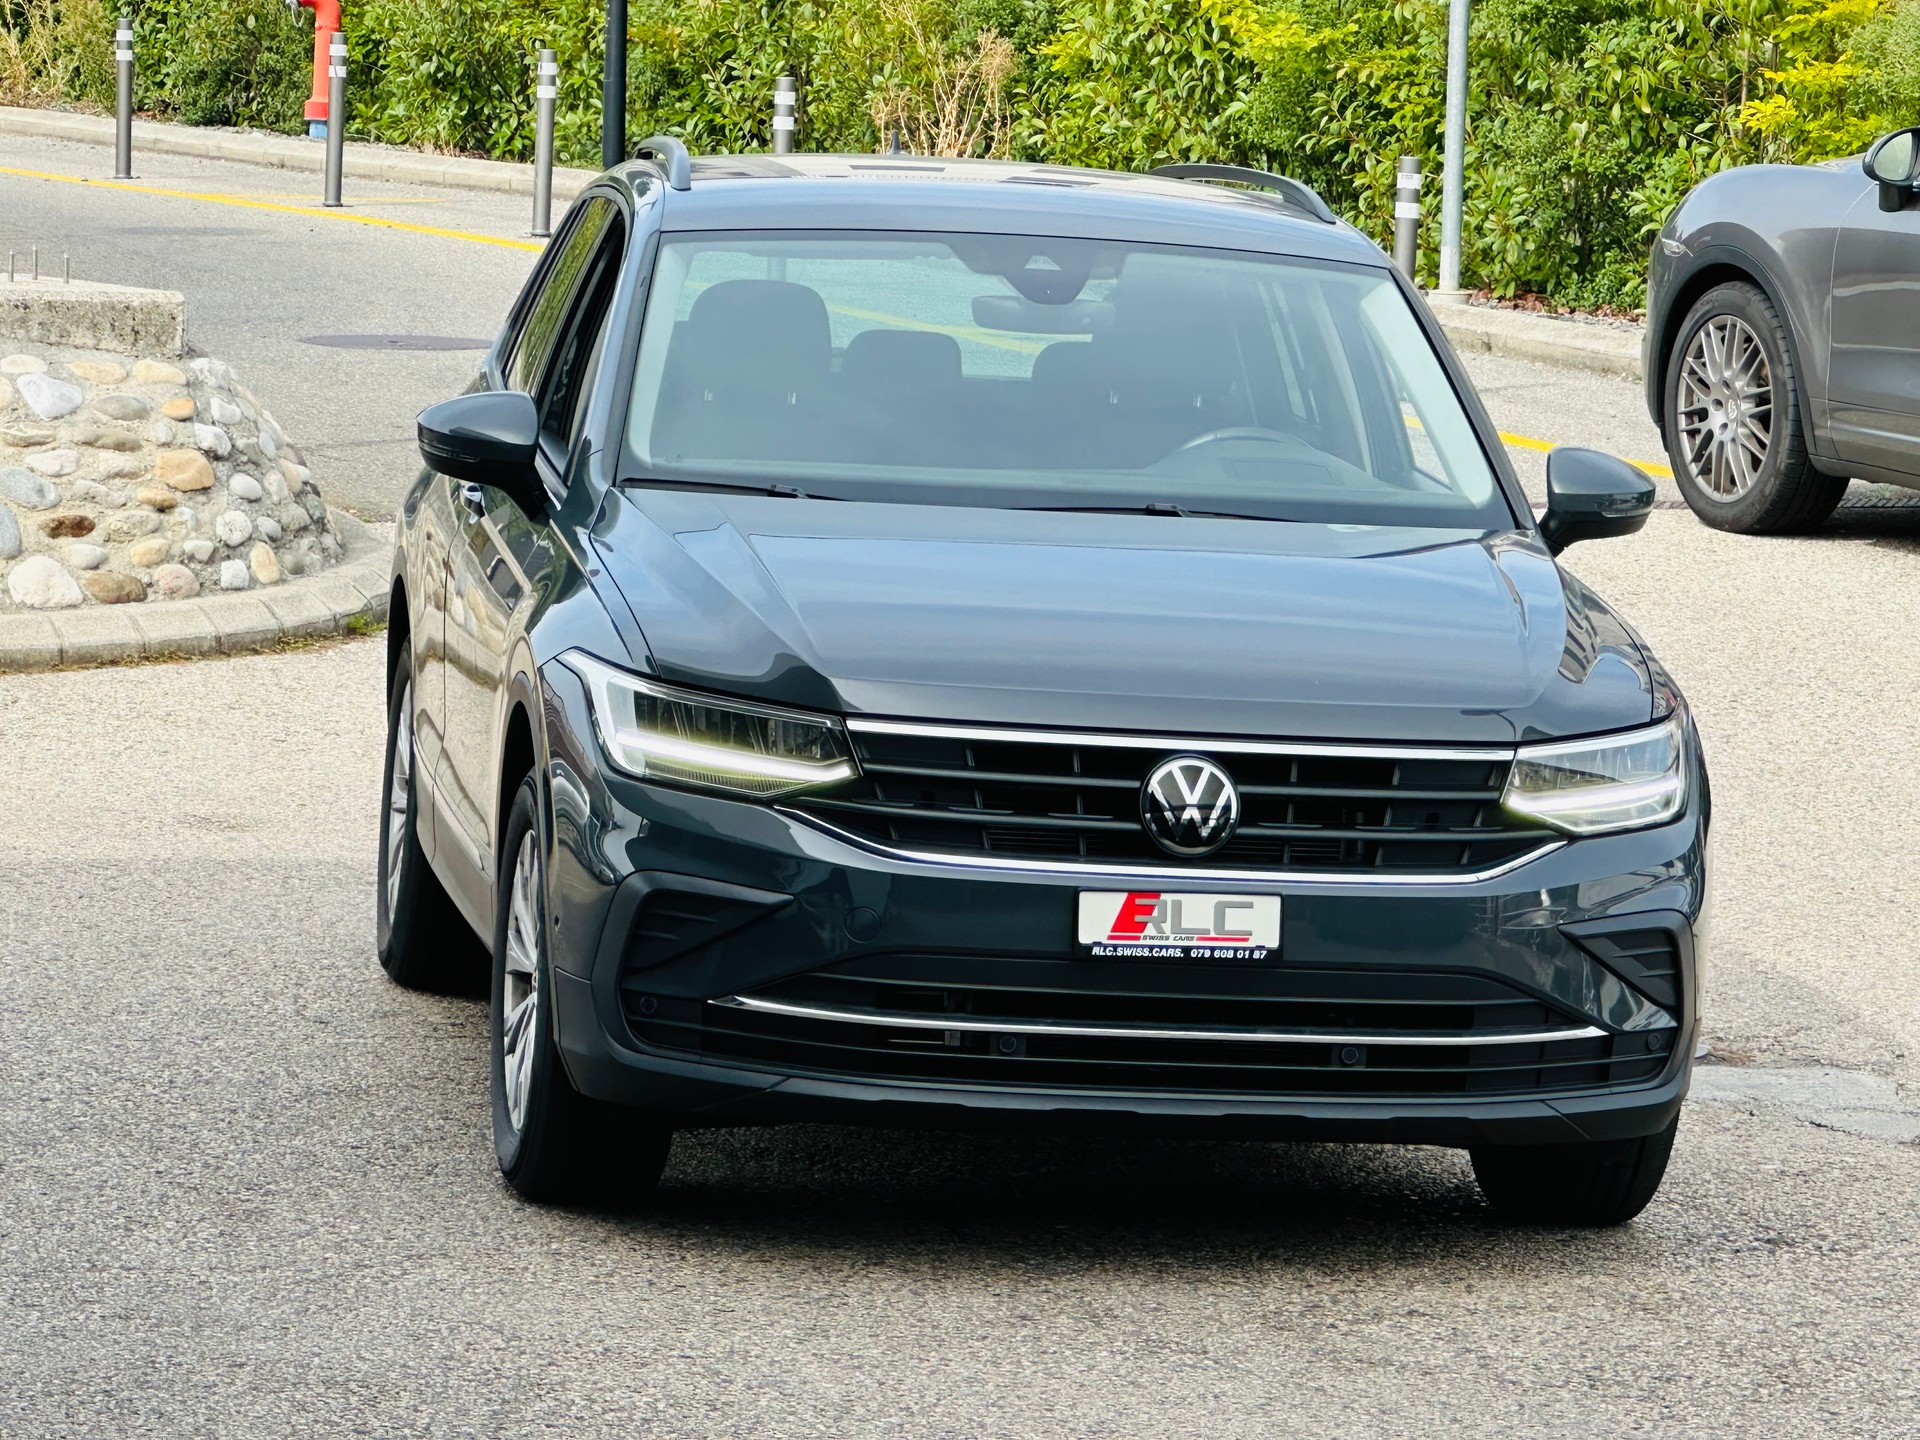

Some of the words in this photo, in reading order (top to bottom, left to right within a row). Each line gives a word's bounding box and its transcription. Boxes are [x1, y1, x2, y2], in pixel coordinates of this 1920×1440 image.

[1132, 897, 1254, 937] RLC
[1190, 948, 1211, 958] 079
[1213, 949, 1235, 959] 608
[1236, 950, 1250, 959] 01
